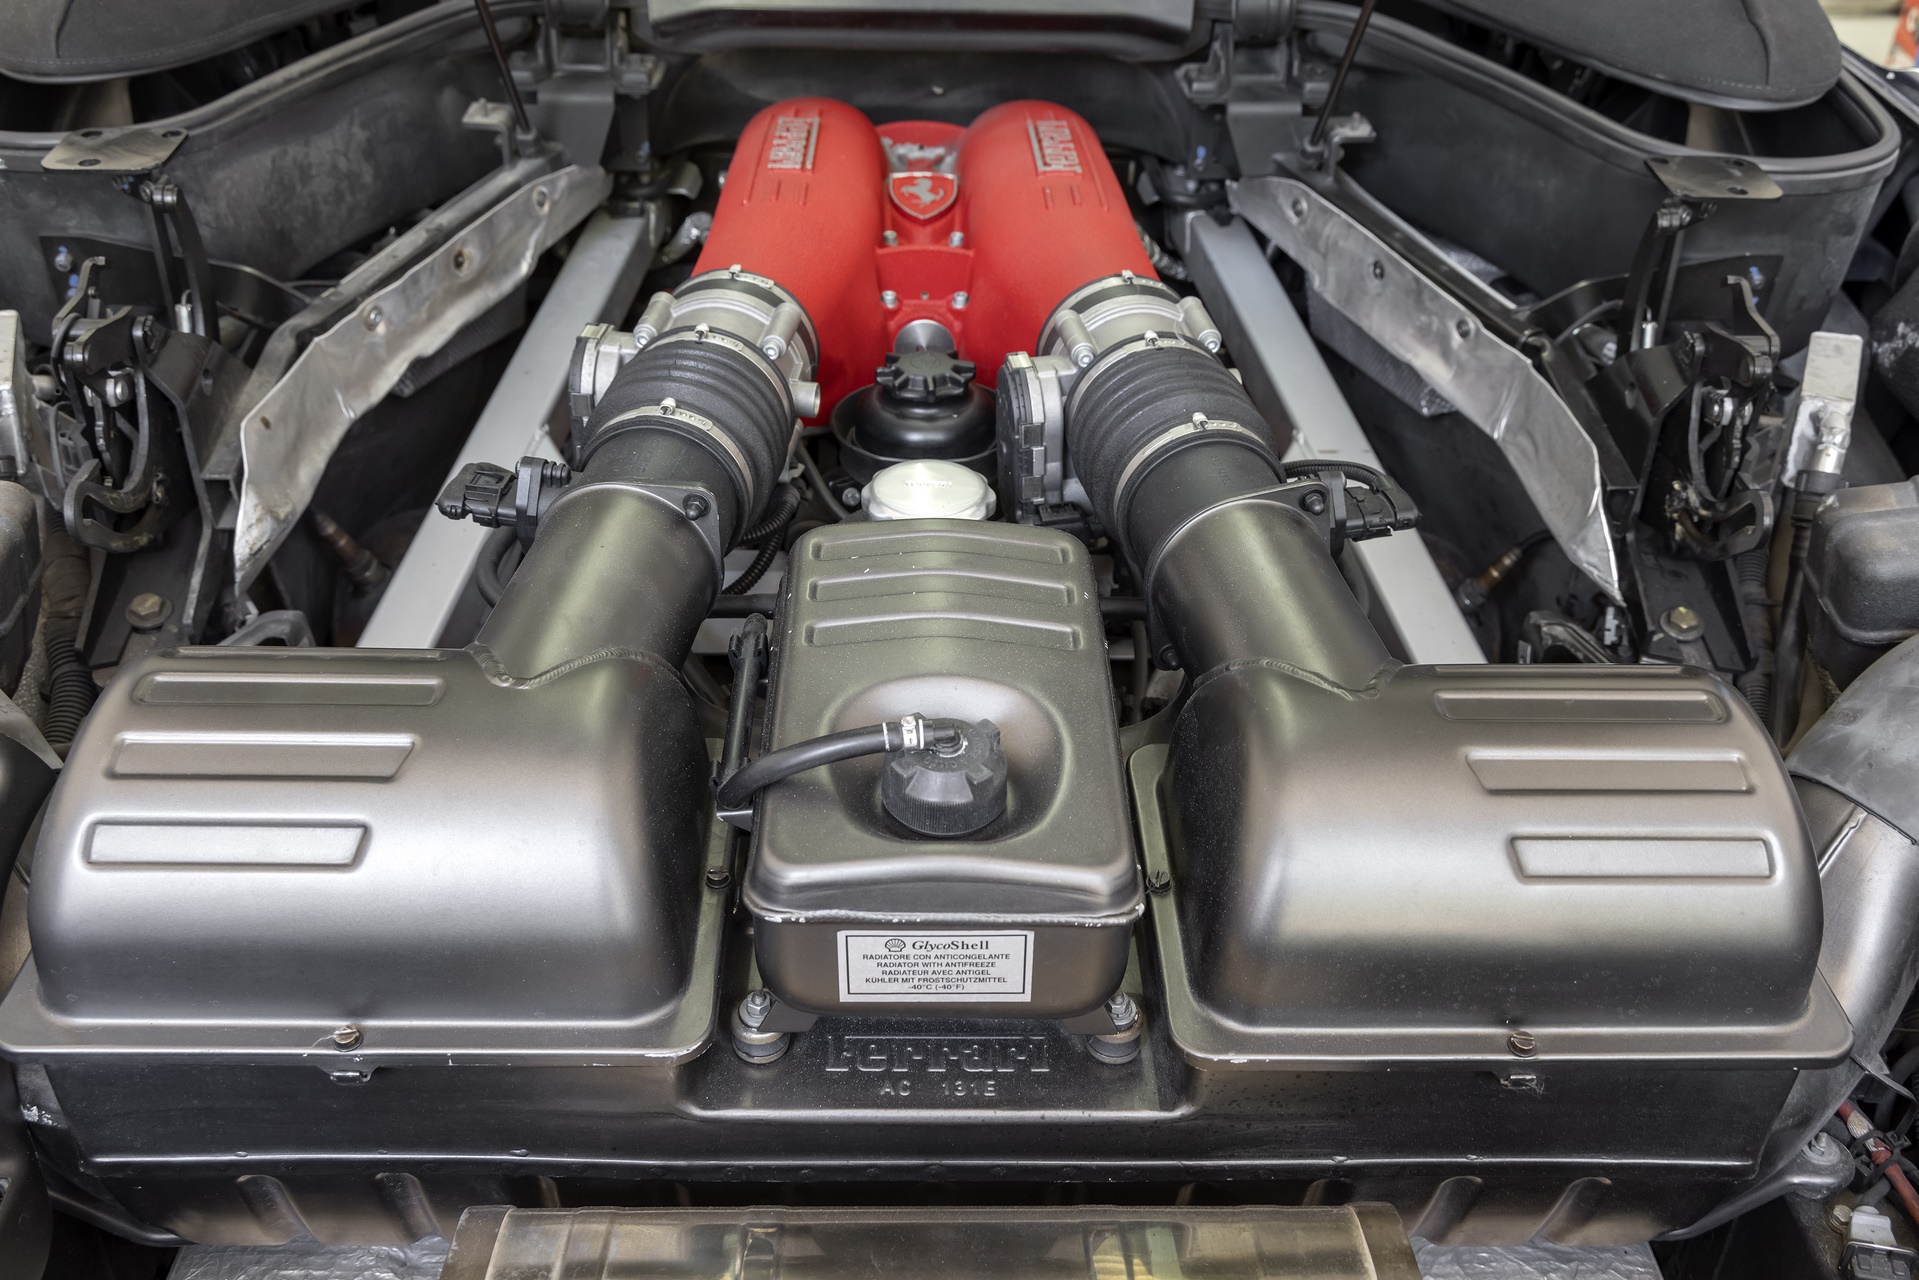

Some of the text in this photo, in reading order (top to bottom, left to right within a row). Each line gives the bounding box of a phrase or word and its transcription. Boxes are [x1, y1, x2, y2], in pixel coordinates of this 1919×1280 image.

[1026, 119, 1082, 173] Ferrari
[912, 940, 989, 951] GlycoShell
[880, 1080, 996, 1096] AC 131E
